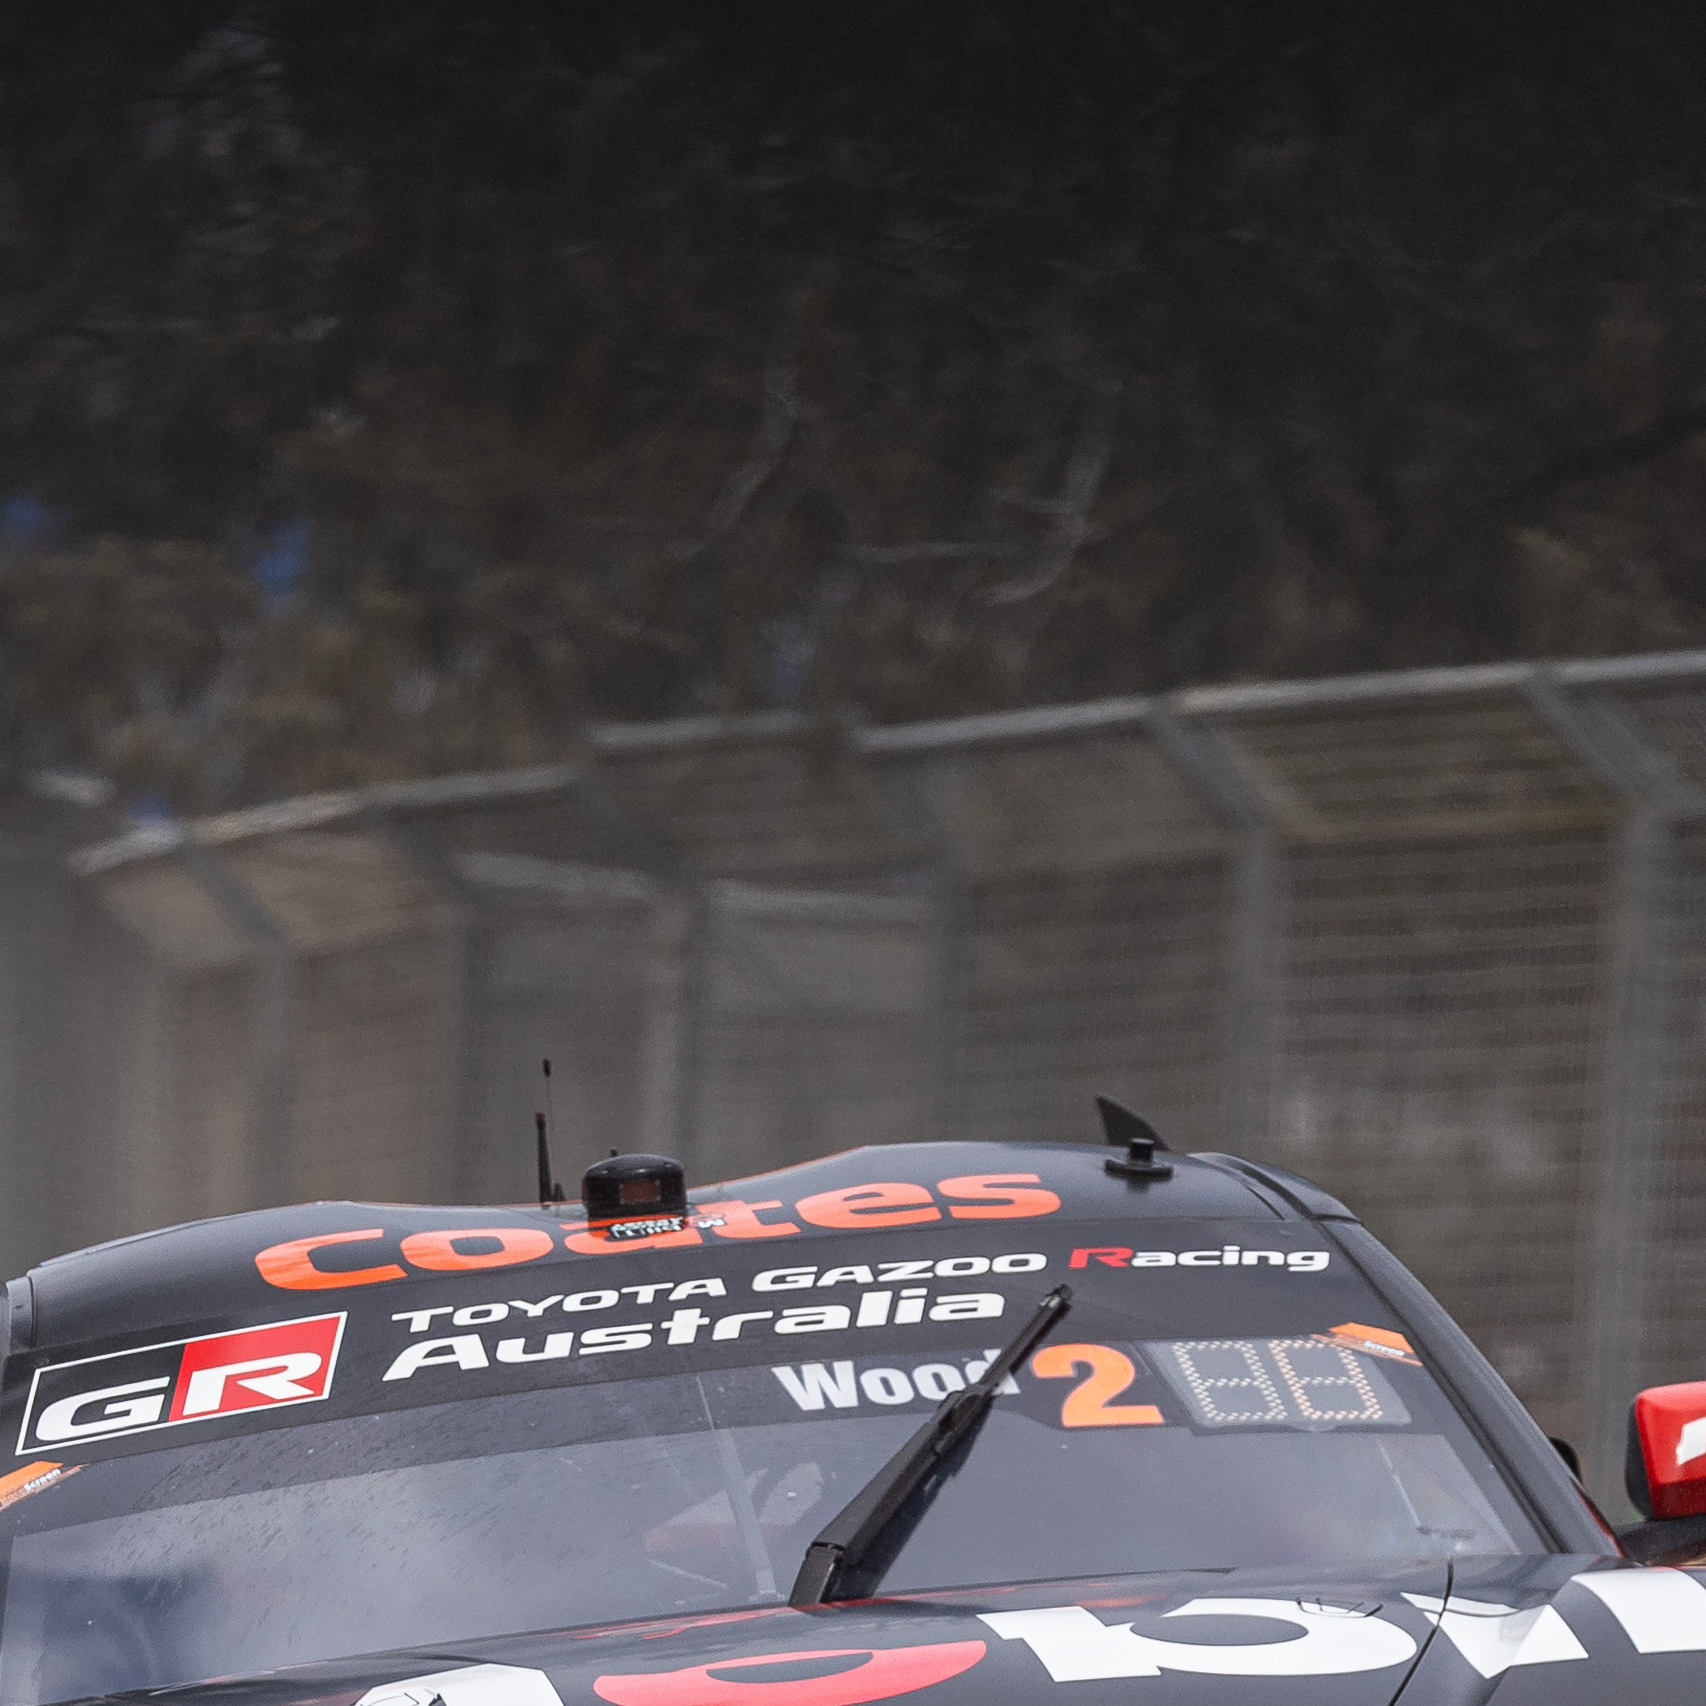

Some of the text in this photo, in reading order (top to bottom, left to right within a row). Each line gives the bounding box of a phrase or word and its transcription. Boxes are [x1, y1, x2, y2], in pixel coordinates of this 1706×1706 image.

[392, 1245, 1331, 1333] TOYOTA GAZOO Racing
[382, 1288, 1005, 1381] Australia
[35, 1350, 323, 1443] GR
[1031, 1343, 1164, 1427] 2
